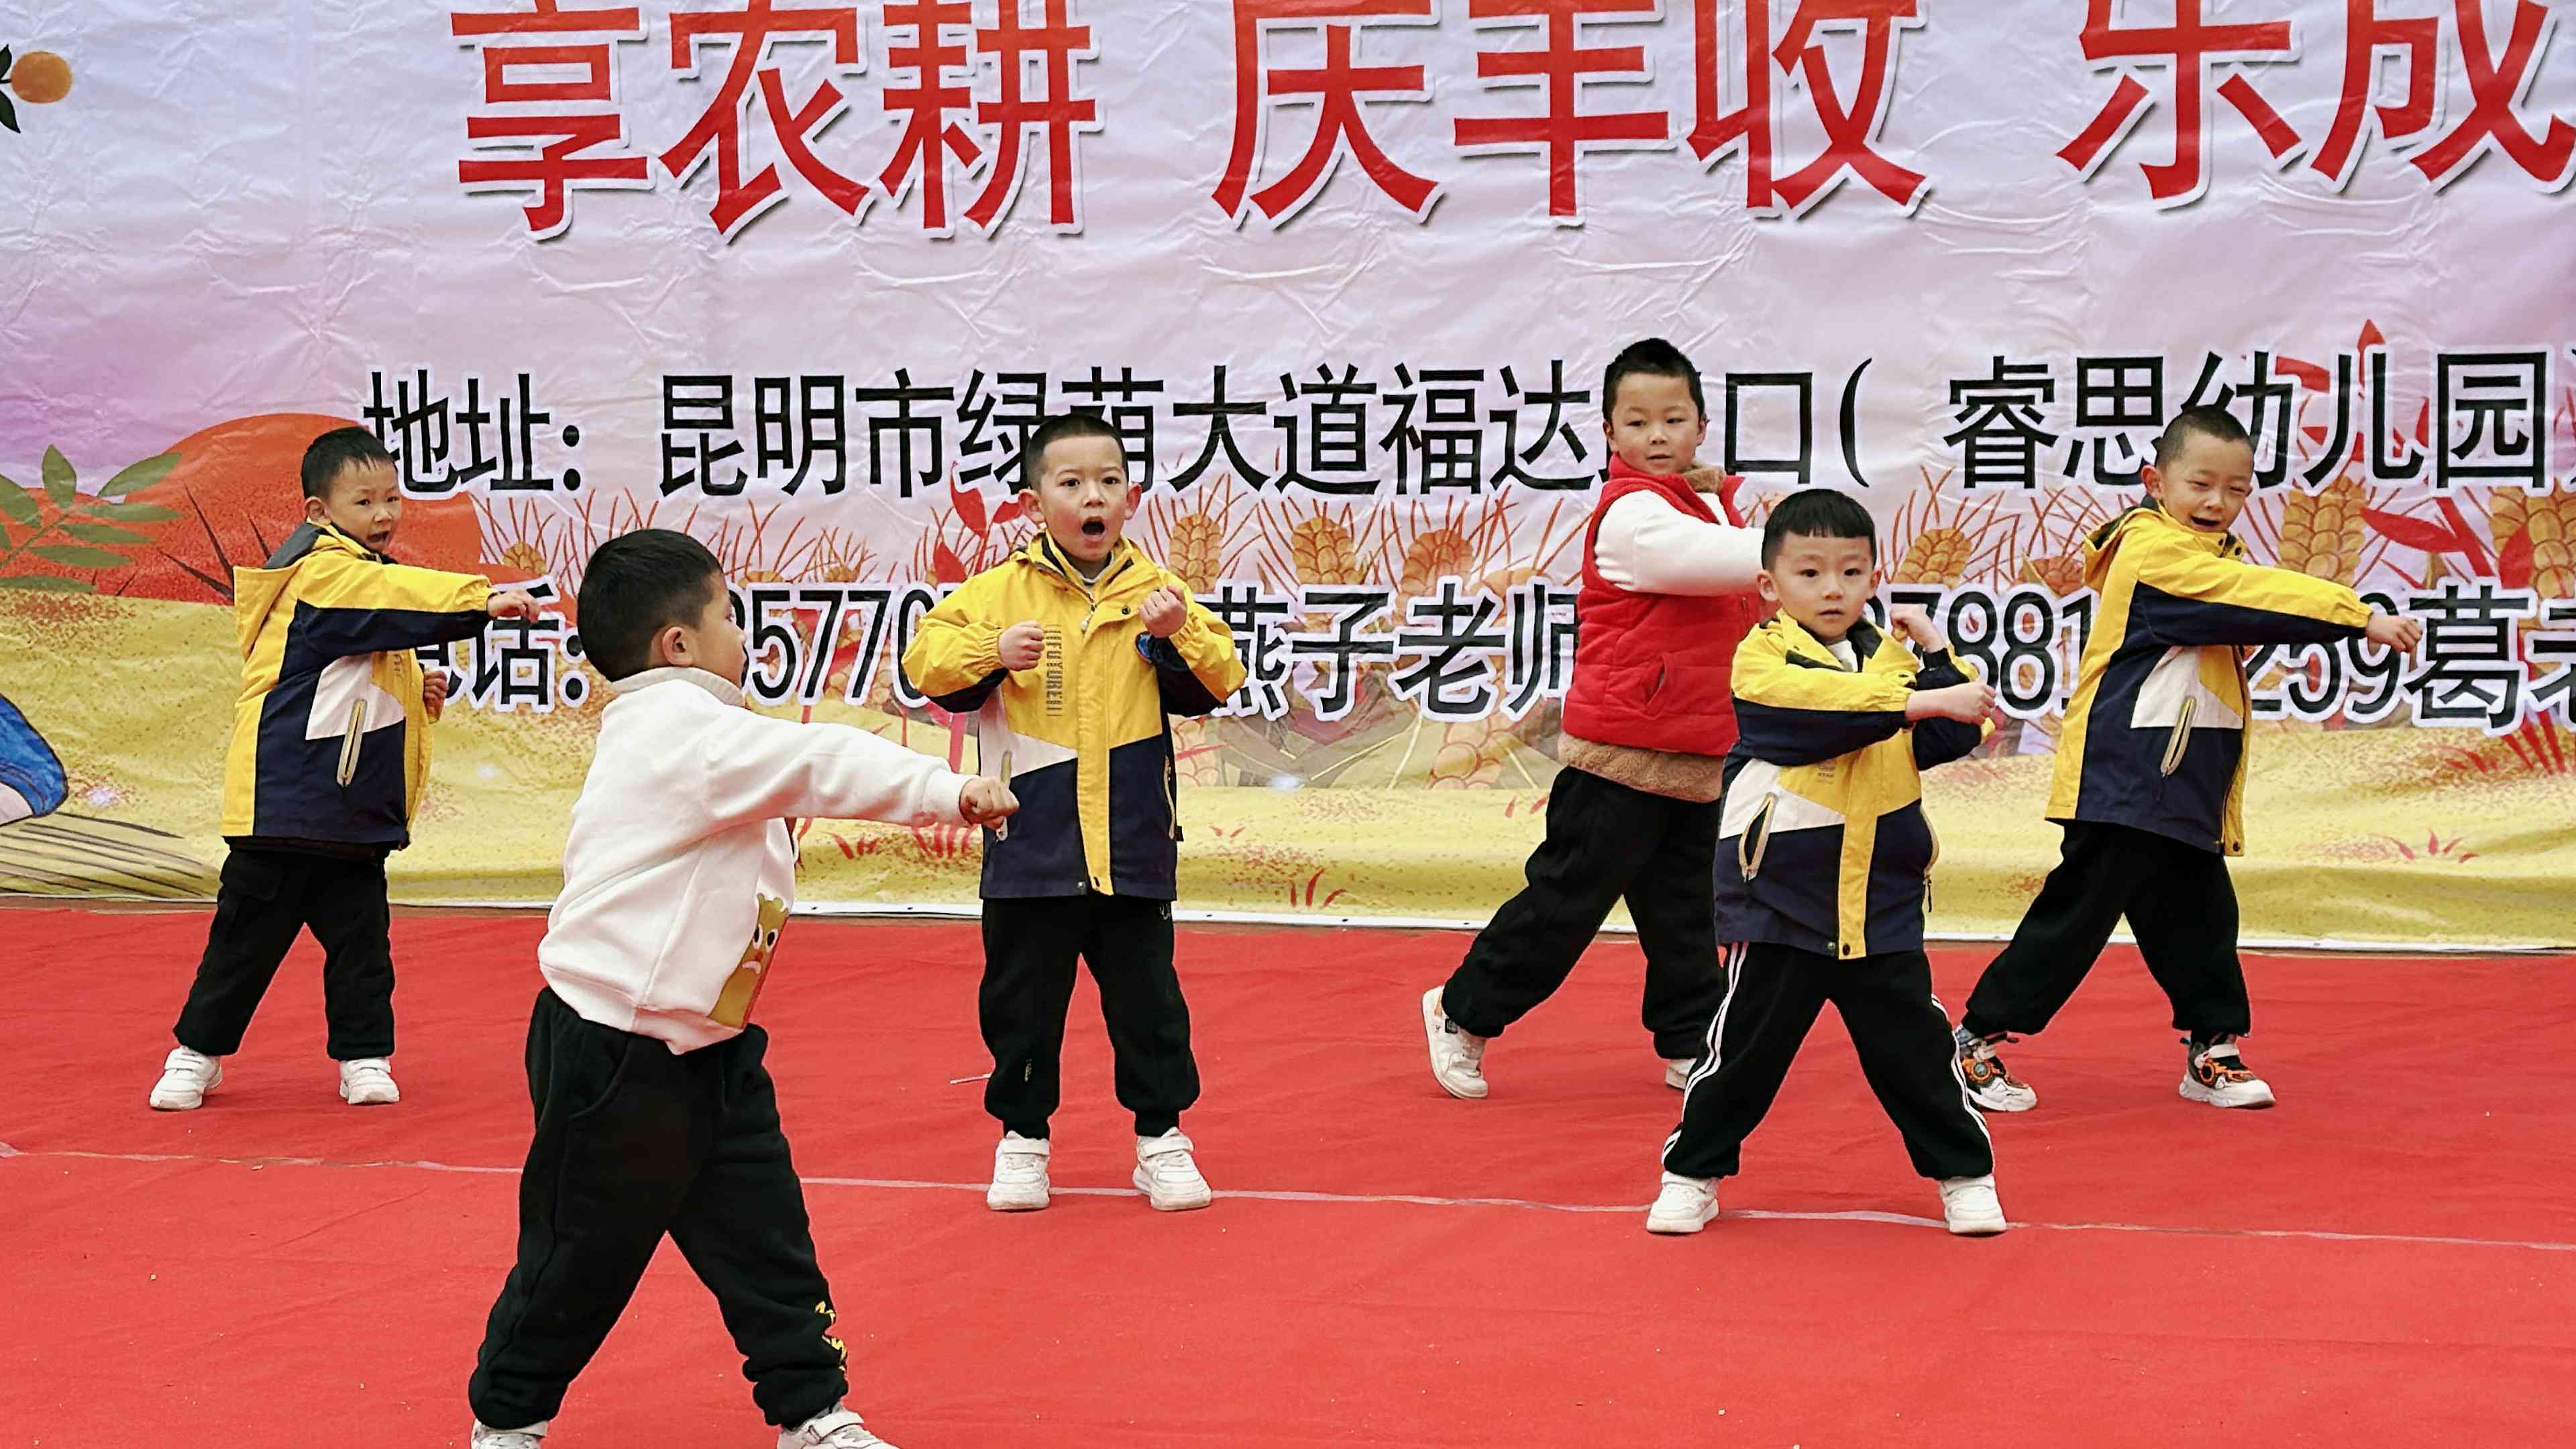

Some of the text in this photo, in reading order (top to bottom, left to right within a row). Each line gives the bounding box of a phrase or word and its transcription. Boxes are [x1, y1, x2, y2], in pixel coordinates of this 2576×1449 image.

[451, 0, 1095, 235] 享农耕
[1212, 0, 1925, 221] 庆丰收
[659, 358, 1872, 497] 昆明市绿萌大道福达口(
[1943, 351, 2576, 489] 睿思幼儿园
